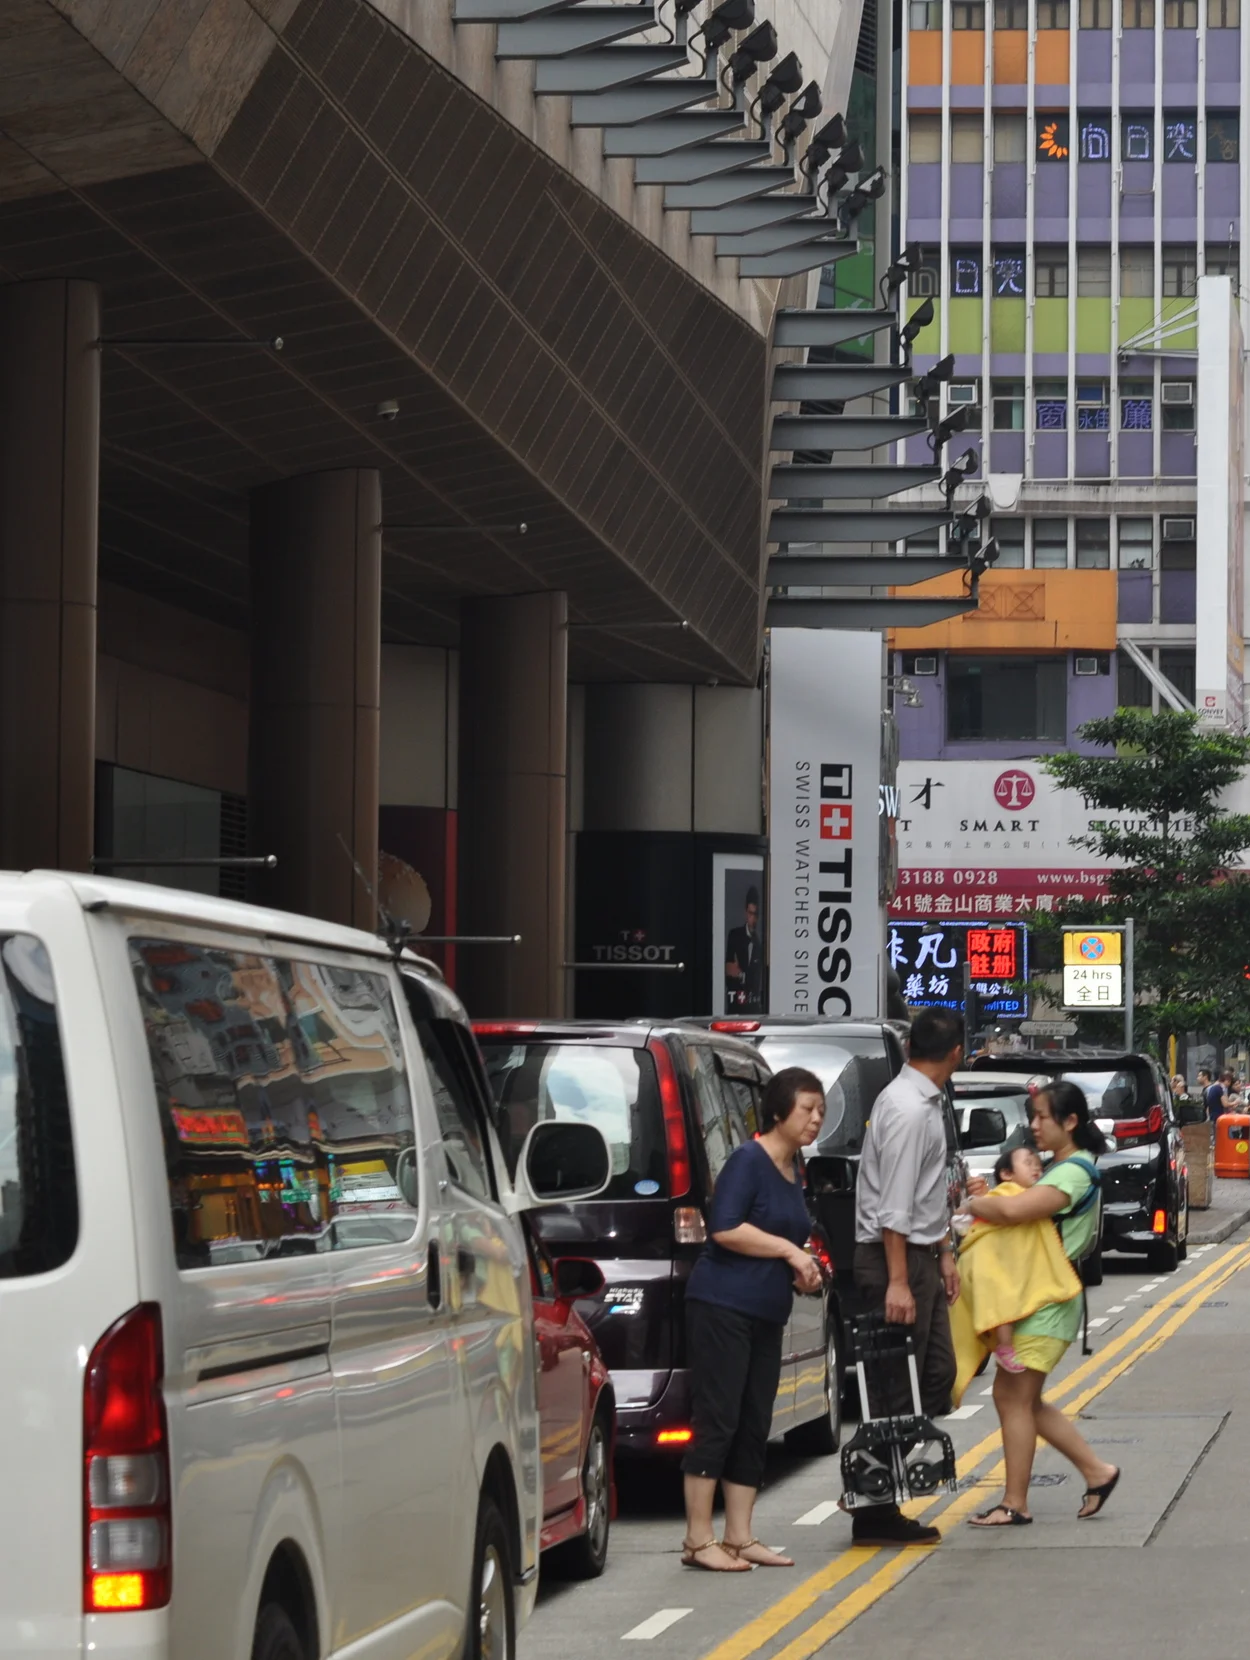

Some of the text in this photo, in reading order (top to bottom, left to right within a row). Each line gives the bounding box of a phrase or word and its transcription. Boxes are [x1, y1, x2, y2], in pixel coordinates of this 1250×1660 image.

[959, 819, 1207, 832] SMART SECURIIES
[900, 870, 945, 885] 3188
[953, 870, 998, 885] 0928
[793, 761, 811, 1013] SWISS WATCHES SINCE
[816, 848, 853, 1016] TISSO
[970, 933, 1013, 954] 政府
[592, 945, 676, 961] TISSOT
[1072, 969, 1113, 980] 24 hrs
[902, 973, 950, 998] 藥坊
[969, 982, 1014, 996] 限公司
[1076, 985, 1110, 1002] 全日
[983, 999, 1020, 1011] IMITED
[603, 1292, 645, 1303] STAR
